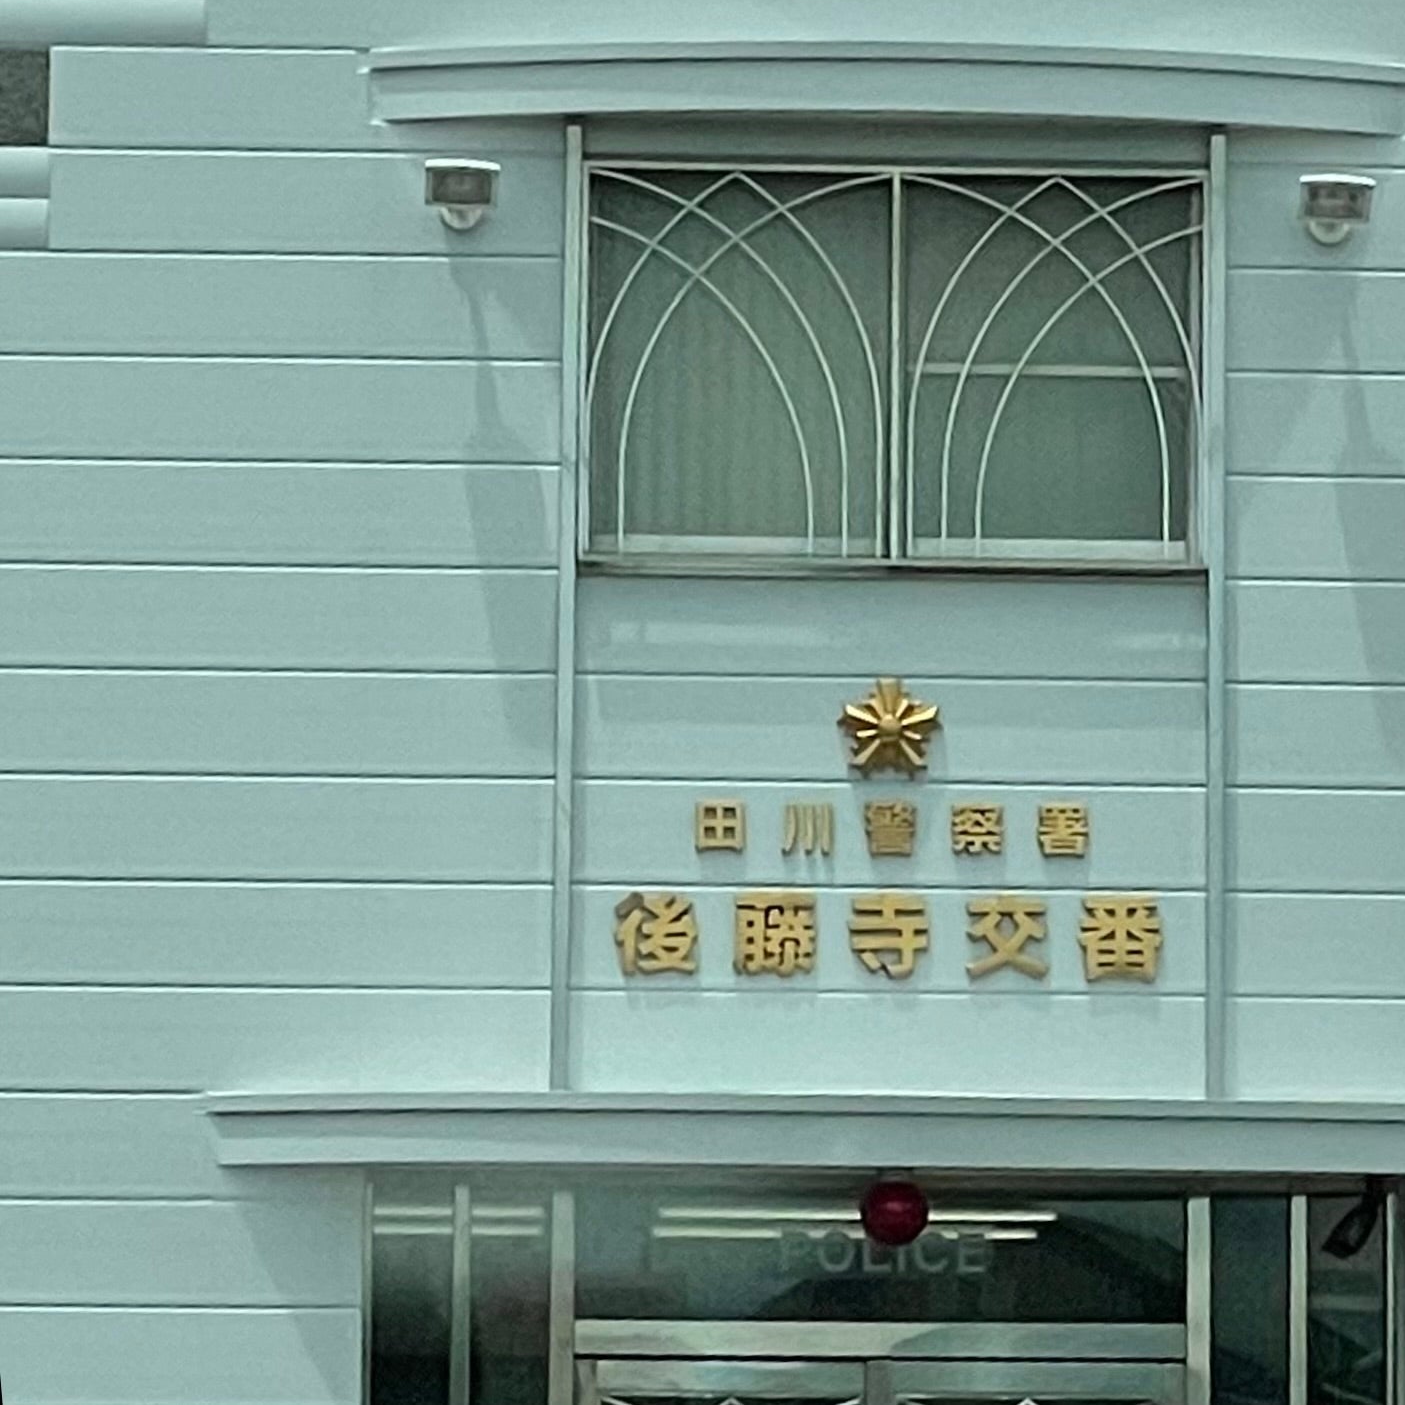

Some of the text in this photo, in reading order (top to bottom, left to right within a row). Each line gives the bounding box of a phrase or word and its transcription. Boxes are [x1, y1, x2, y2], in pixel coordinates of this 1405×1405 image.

[694, 800, 1090, 856] 田川警察署
[613, 892, 1163, 983] 後藤寺交番
[779, 1230, 988, 1273] POLICE
